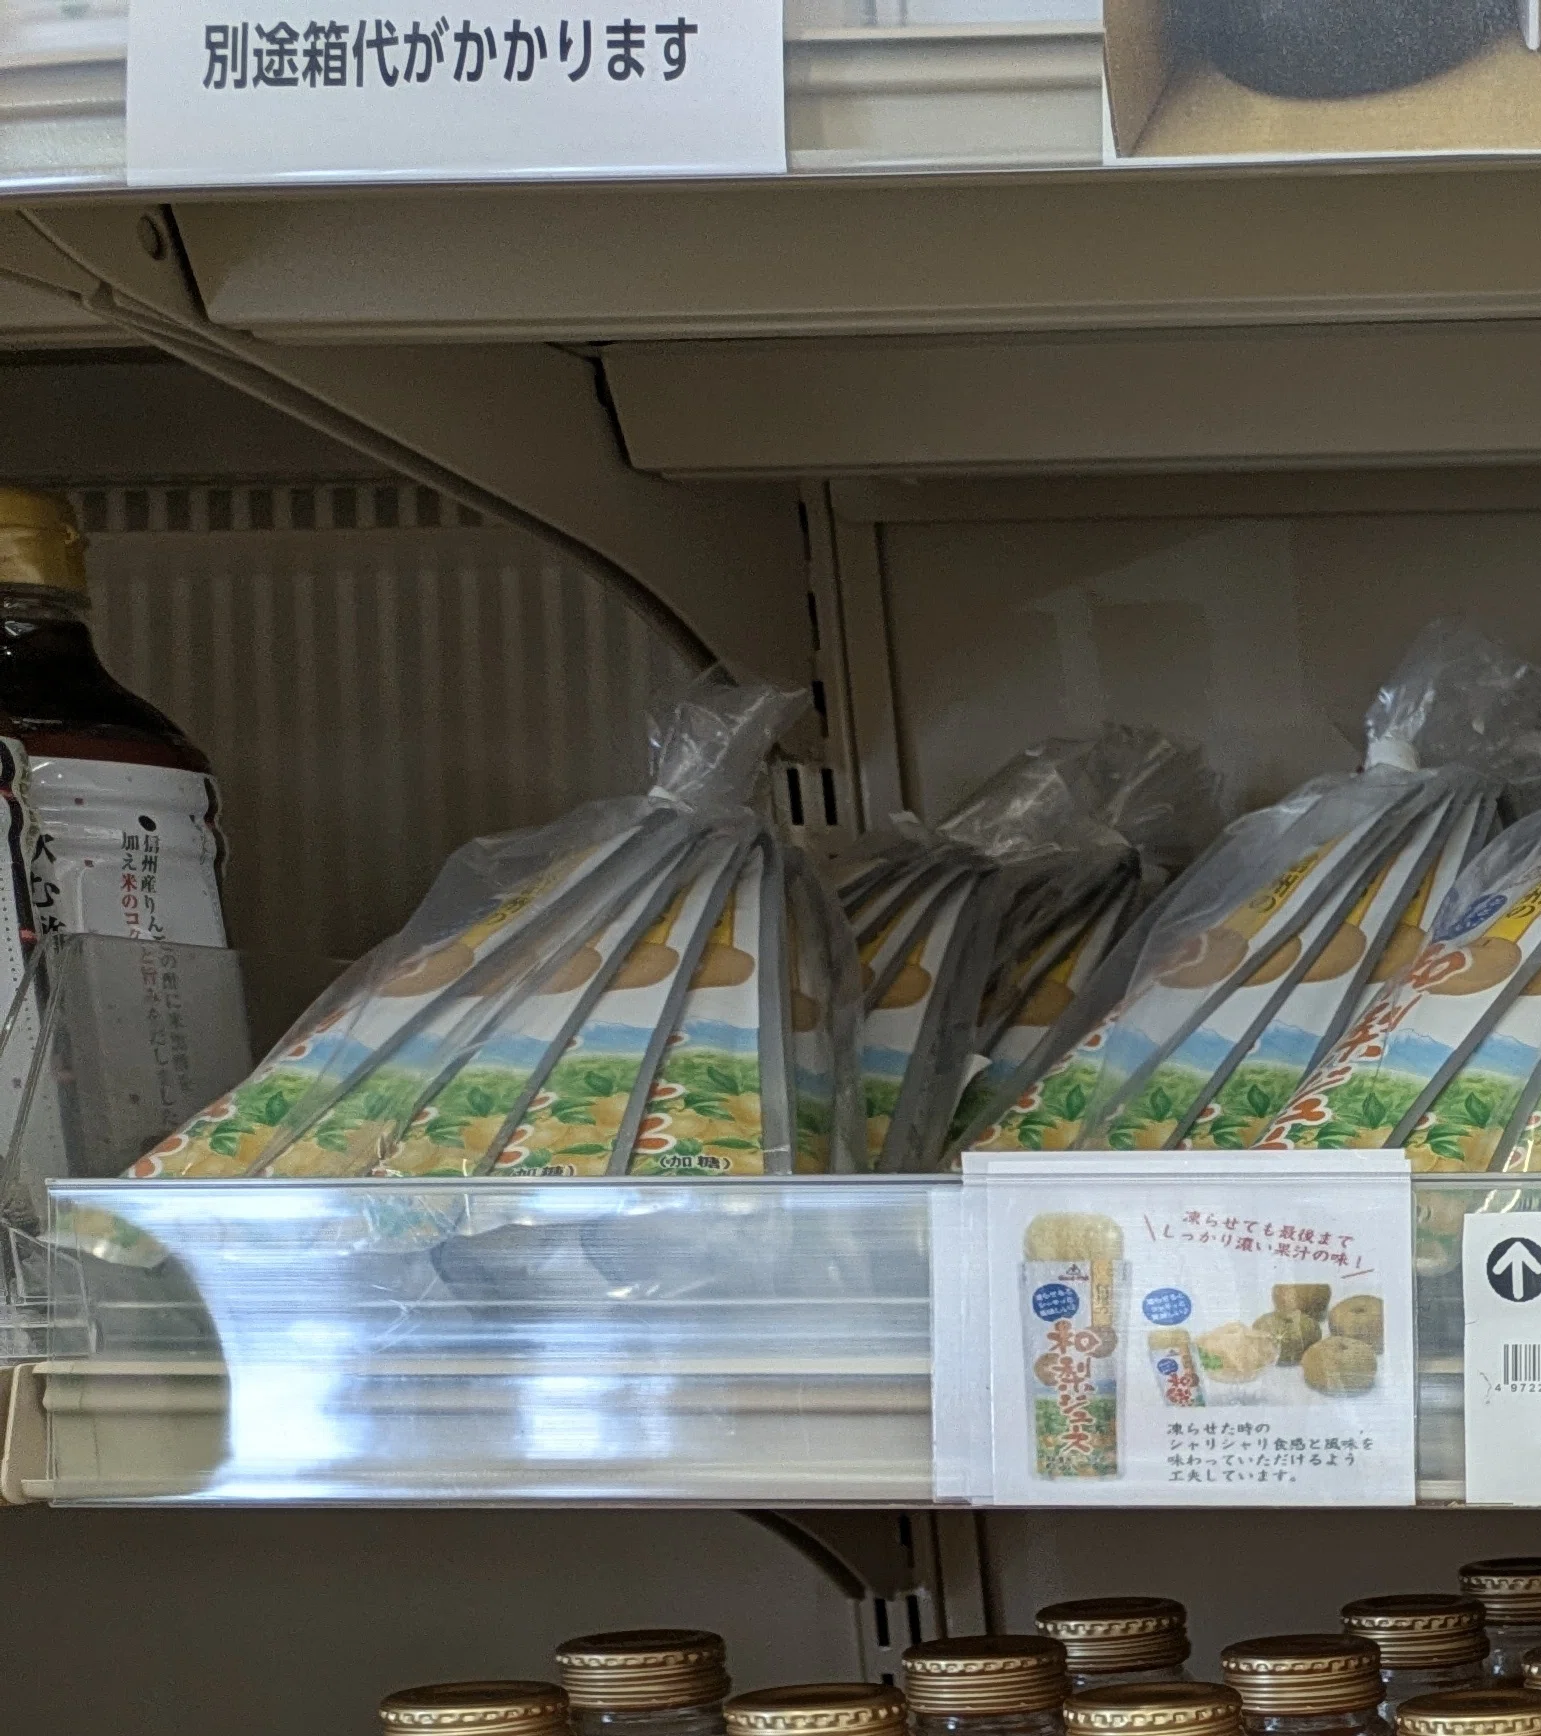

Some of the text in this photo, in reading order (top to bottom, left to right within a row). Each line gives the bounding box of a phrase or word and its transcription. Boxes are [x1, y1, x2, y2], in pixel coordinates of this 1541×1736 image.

[203, 15, 700, 89] 別途箱代がかかります
[1184, 1210, 1354, 1249] 凍らせても最後まで
[1168, 1422, 1270, 1436] 凍らせた時の
[1168, 1438, 1374, 1452] シャリシャリ食感と風味を
[1168, 1453, 1356, 1467] 味わっていただけるよう
[1168, 1469, 1298, 1484] 工夫しています。
